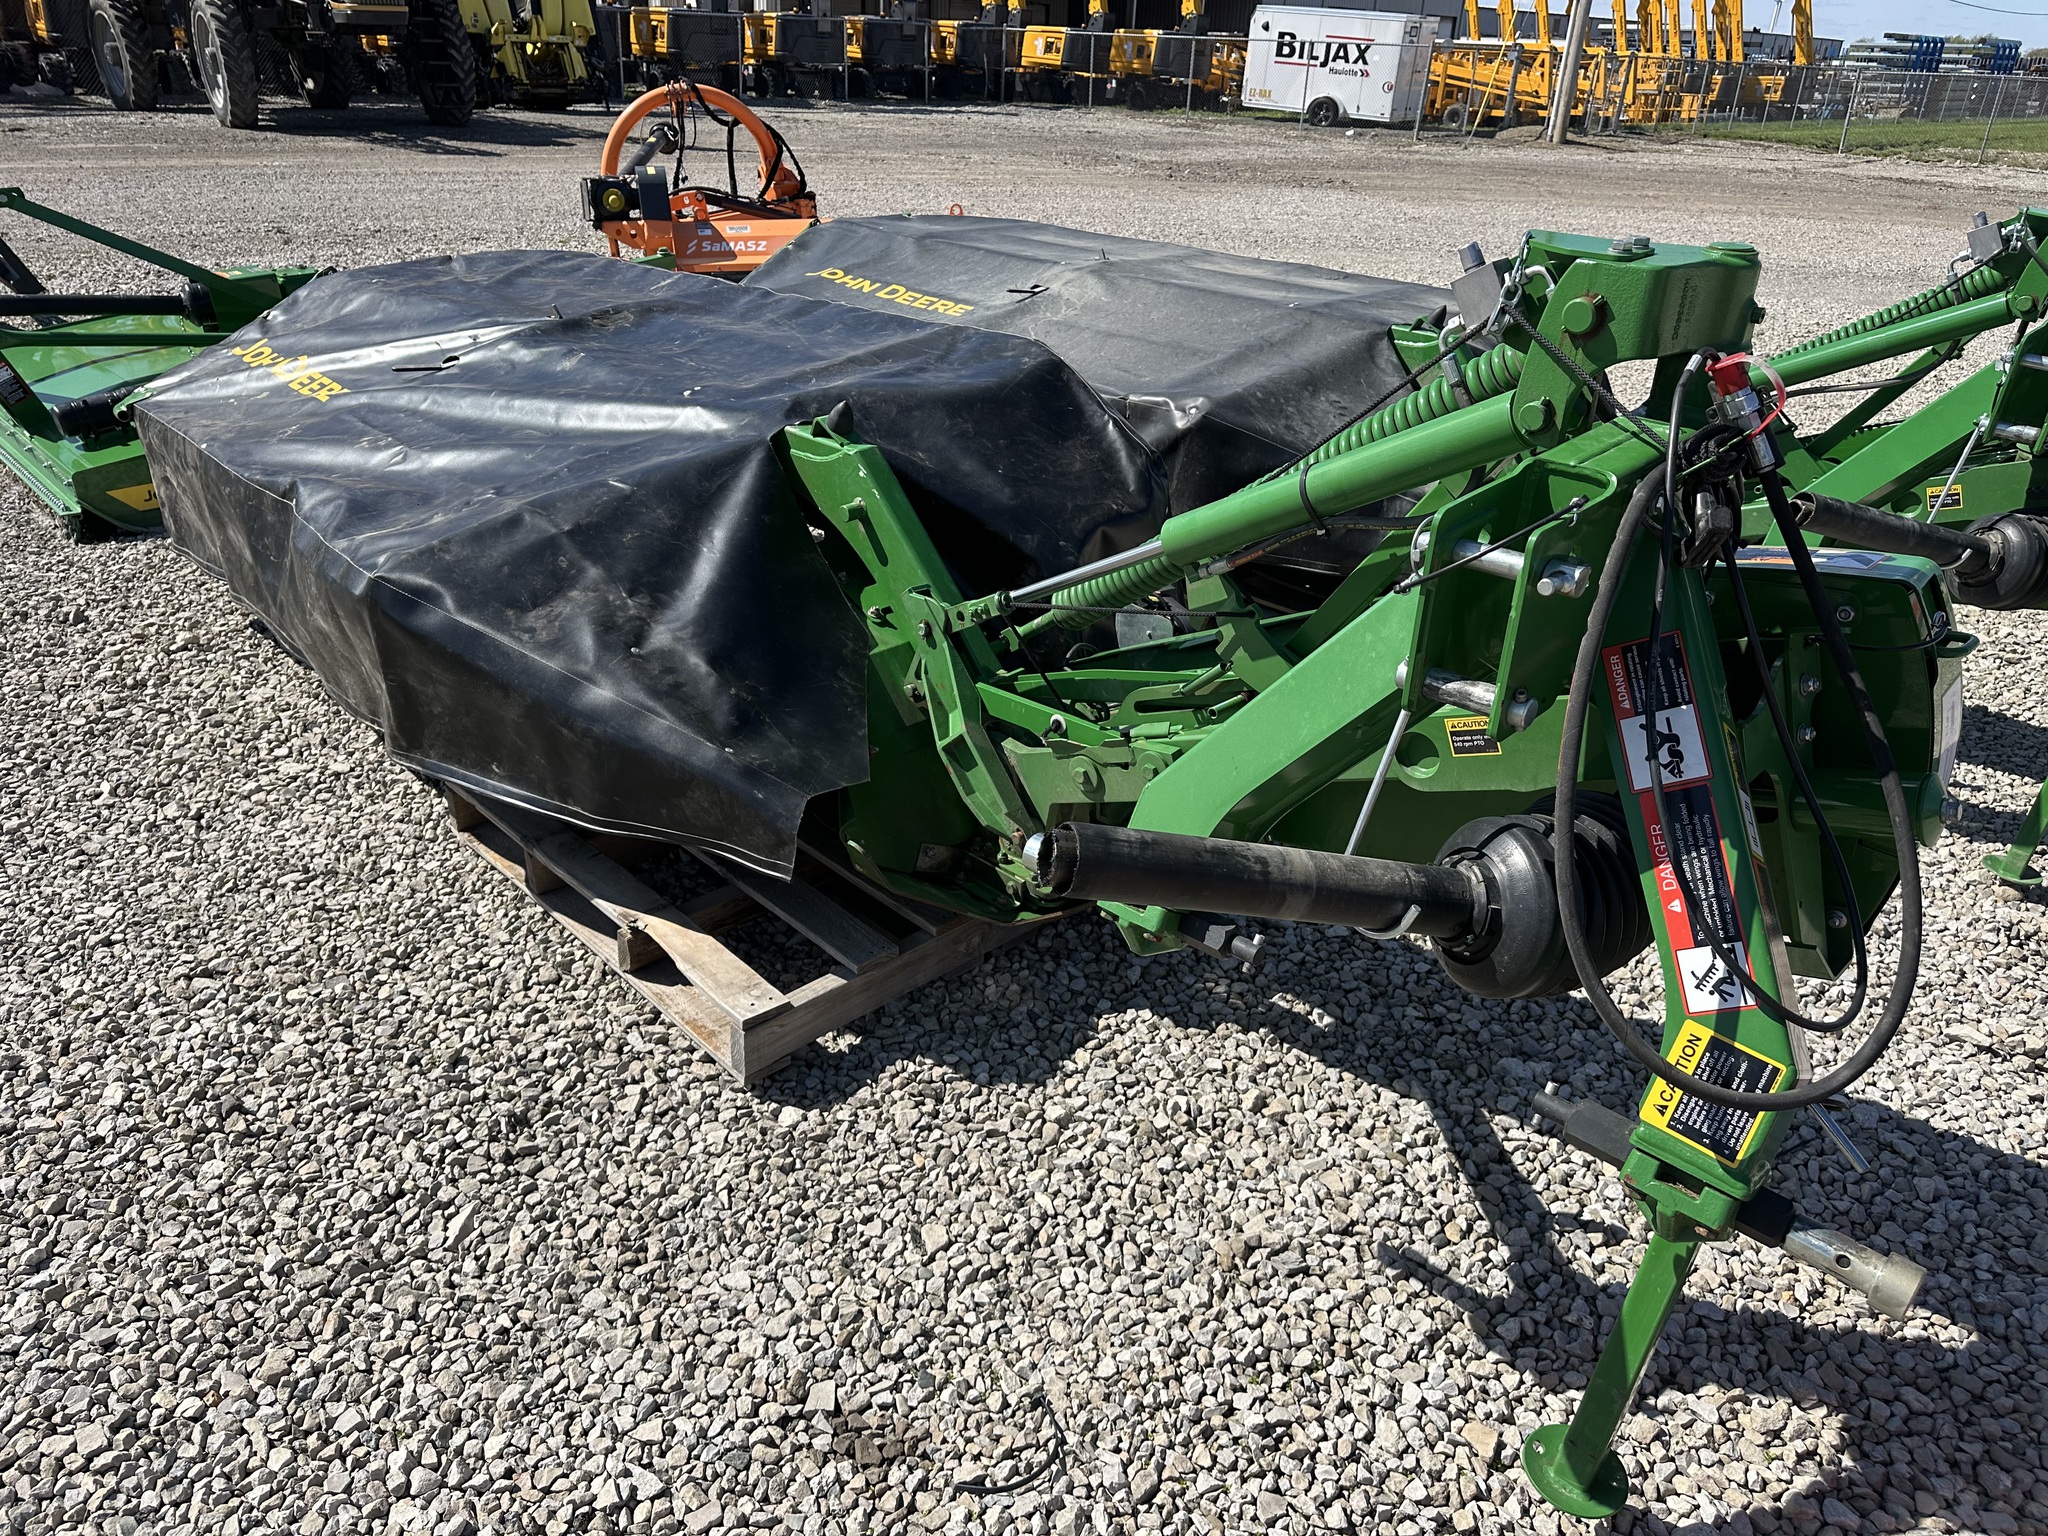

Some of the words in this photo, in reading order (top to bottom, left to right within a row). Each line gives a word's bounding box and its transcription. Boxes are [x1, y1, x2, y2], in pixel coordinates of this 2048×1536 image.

[1328, 66, 1359, 77] Haulotte
[701, 240, 768, 252] SaMASZ
[805, 267, 881, 293] JOHN
[875, 284, 975, 316] DEERE
[1610, 655, 1628, 700] DANGER
[1671, 669, 1679, 688] contact
[1632, 678, 1643, 712] Entanglement
[1675, 688, 1683, 702] Avoid
[1679, 803, 1689, 824] folded
[1674, 823, 1683, 839] clear
[1685, 825, 1694, 845] being
[1693, 814, 1705, 845] hydraulic
[1651, 823, 1676, 890] DANGER
[1677, 840, 1688, 860] stand
[1711, 849, 1717, 857] to
[1693, 858, 1702, 879] wings
[1701, 855, 1715, 895] Mechanical
[1713, 858, 1722, 878] wings
[1697, 880, 1706, 899] when
[1718, 880, 1727, 898] allow
[1722, 899, 1730, 912] can
[1718, 929, 1725, 938] or
[1726, 914, 1735, 936] failure
[1697, 931, 1705, 941] To
[1659, 1033, 1703, 1101] CATION
[1702, 1066, 1711, 1081] shut
[1673, 1103, 1685, 1119] Keep
[1700, 1052, 1710, 1069] place
[1688, 1106, 1700, 1125] engine
[1716, 1051, 1727, 1070] power
[1694, 1110, 1707, 1129] before
[1717, 1076, 1723, 1084] or
[1707, 1121, 1719, 1136] Keep
[1731, 1077, 1740, 1089] and
[1727, 1138, 1736, 1147] Do
[1733, 1127, 1741, 1138] not
[1737, 1111, 1749, 1127] leave
[1758, 1064, 1773, 1089] machine
[1701, 1119, 1712, 1133] ging
[1714, 1130, 1724, 1140] ing
[1720, 1114, 1731, 1130] away
[1721, 1125, 1734, 1143] driven
[1735, 1118, 1754, 1150] unattended.
